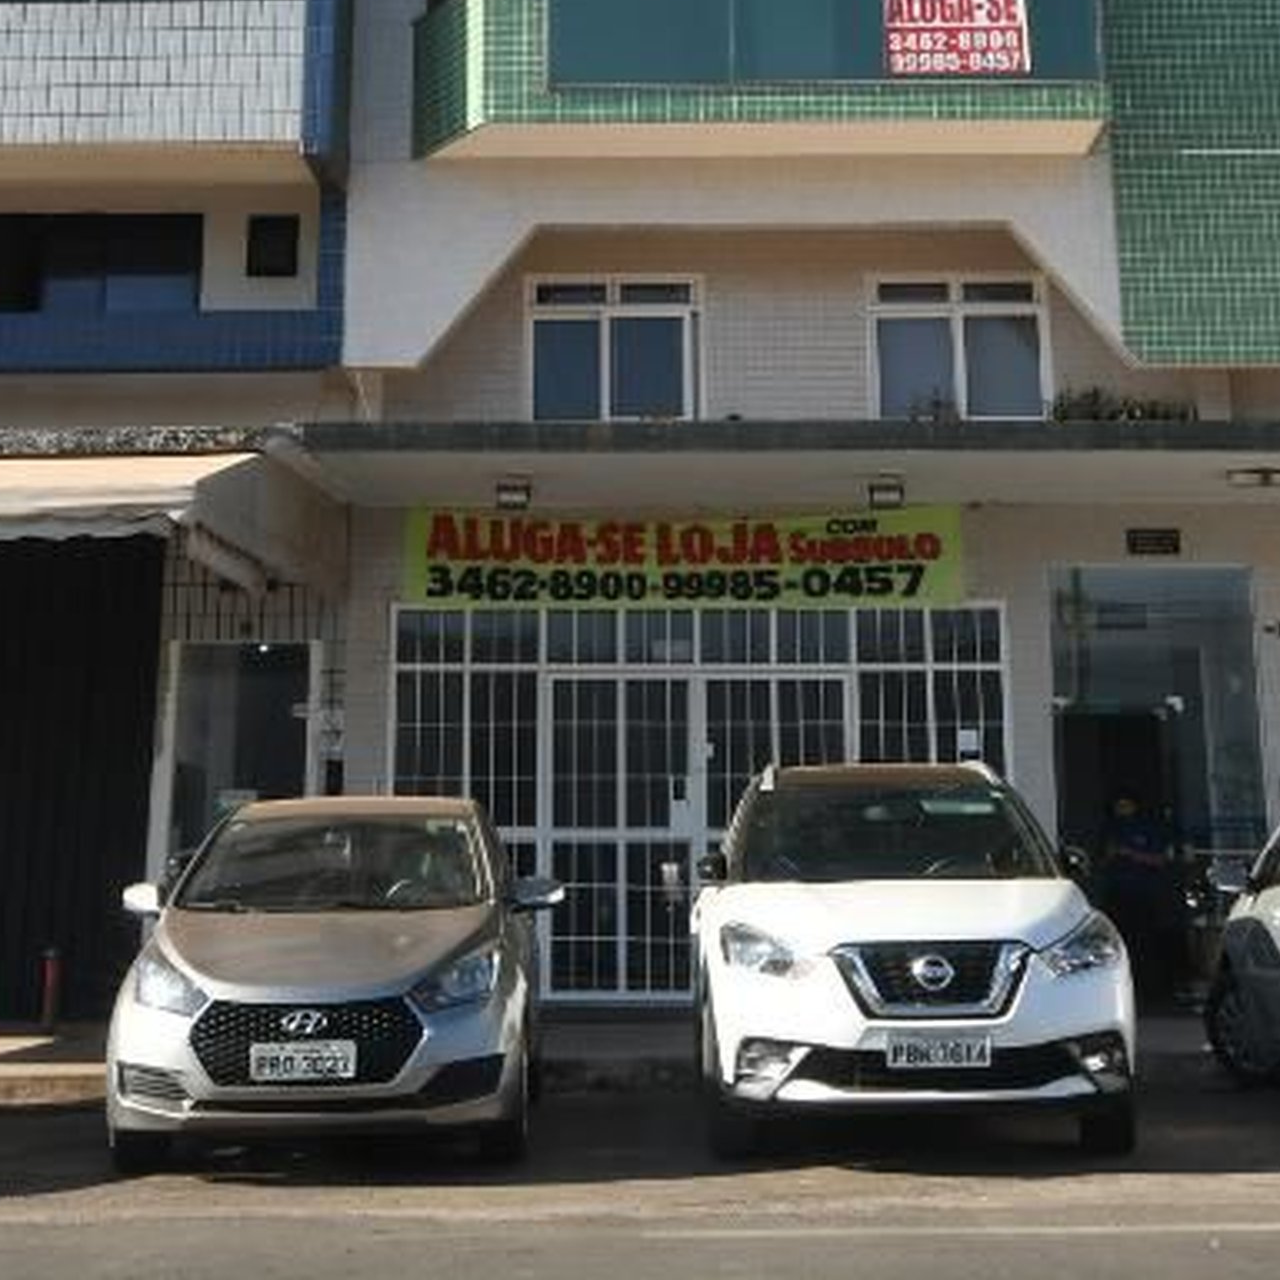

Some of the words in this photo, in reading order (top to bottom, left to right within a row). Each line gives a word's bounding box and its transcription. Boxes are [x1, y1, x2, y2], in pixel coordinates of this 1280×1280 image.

[888, 31, 1019, 51] 3462-8900
[426, 511, 646, 565] ALUGA-SE
[656, 520, 782, 565] LOJA
